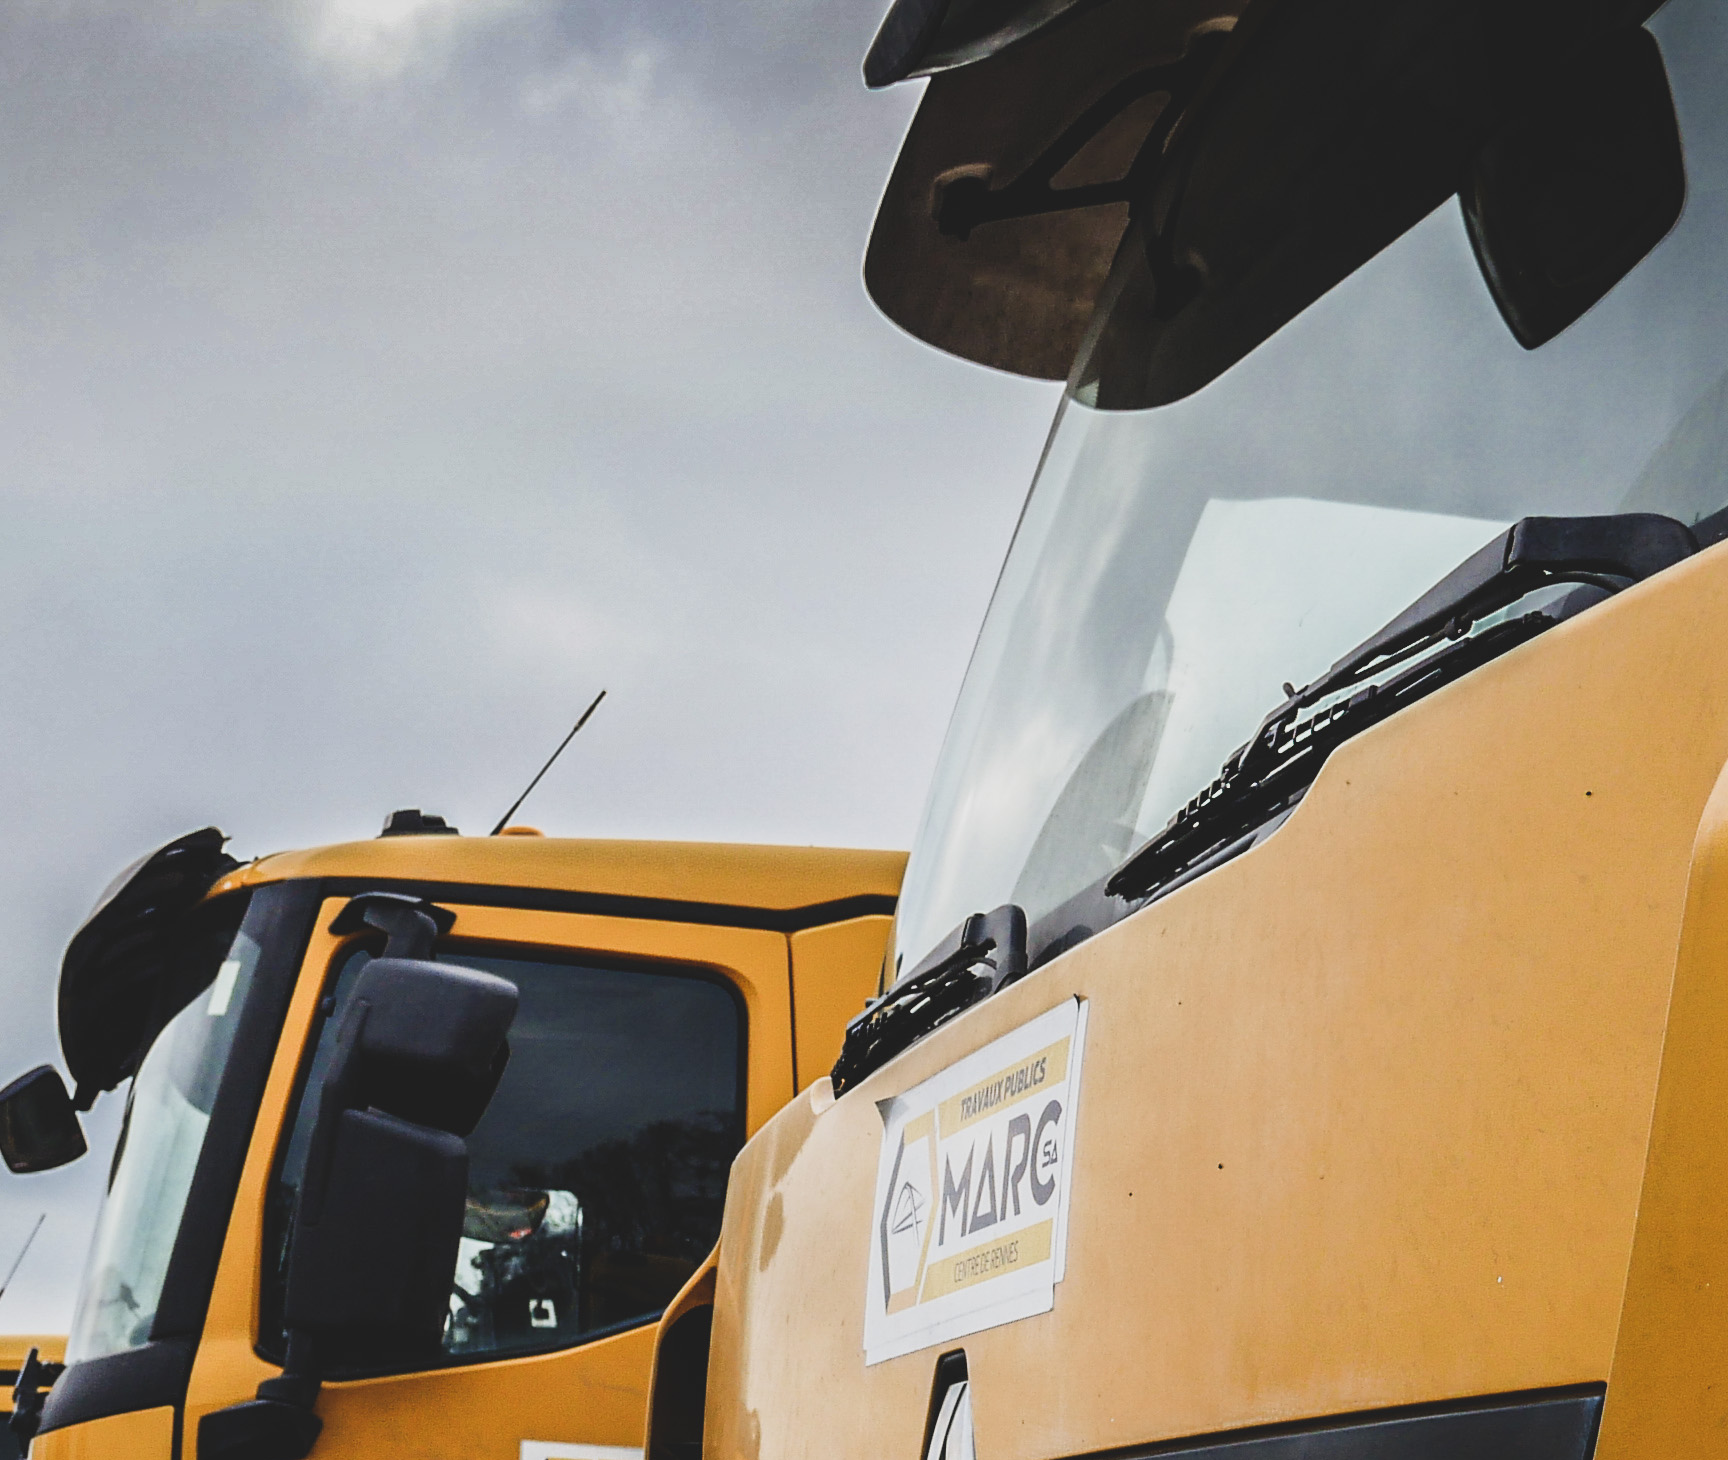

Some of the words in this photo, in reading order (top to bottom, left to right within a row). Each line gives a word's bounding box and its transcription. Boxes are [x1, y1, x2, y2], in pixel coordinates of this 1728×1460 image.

[960, 1078, 1004, 1122] TRAVAUX
[1004, 1056, 1047, 1101] PUBLICS
[938, 1099, 1063, 1247] MARC
